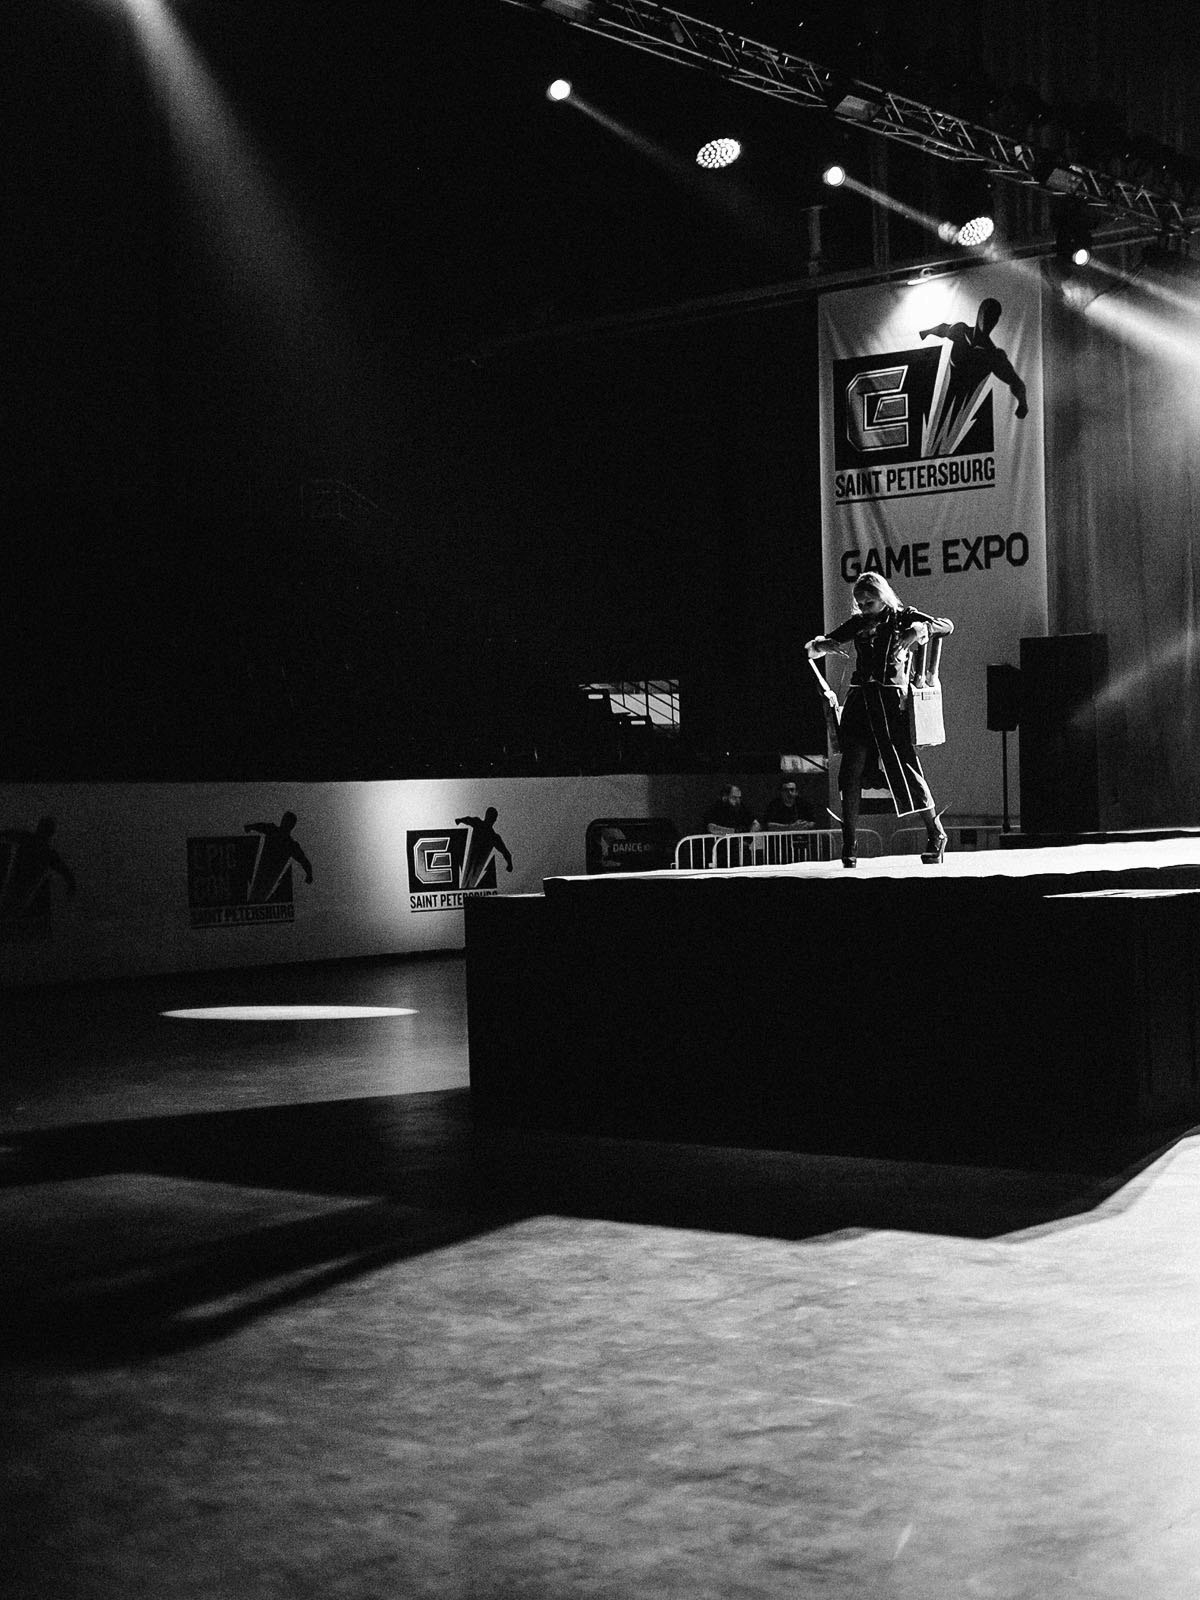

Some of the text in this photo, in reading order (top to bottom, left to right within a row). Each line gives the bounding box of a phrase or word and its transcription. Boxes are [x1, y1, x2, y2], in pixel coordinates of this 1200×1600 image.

[835, 457, 995, 498] SAINT PETERSBURG
[841, 532, 1029, 582] GAME EXPO
[410, 895, 438, 909] SAINT
